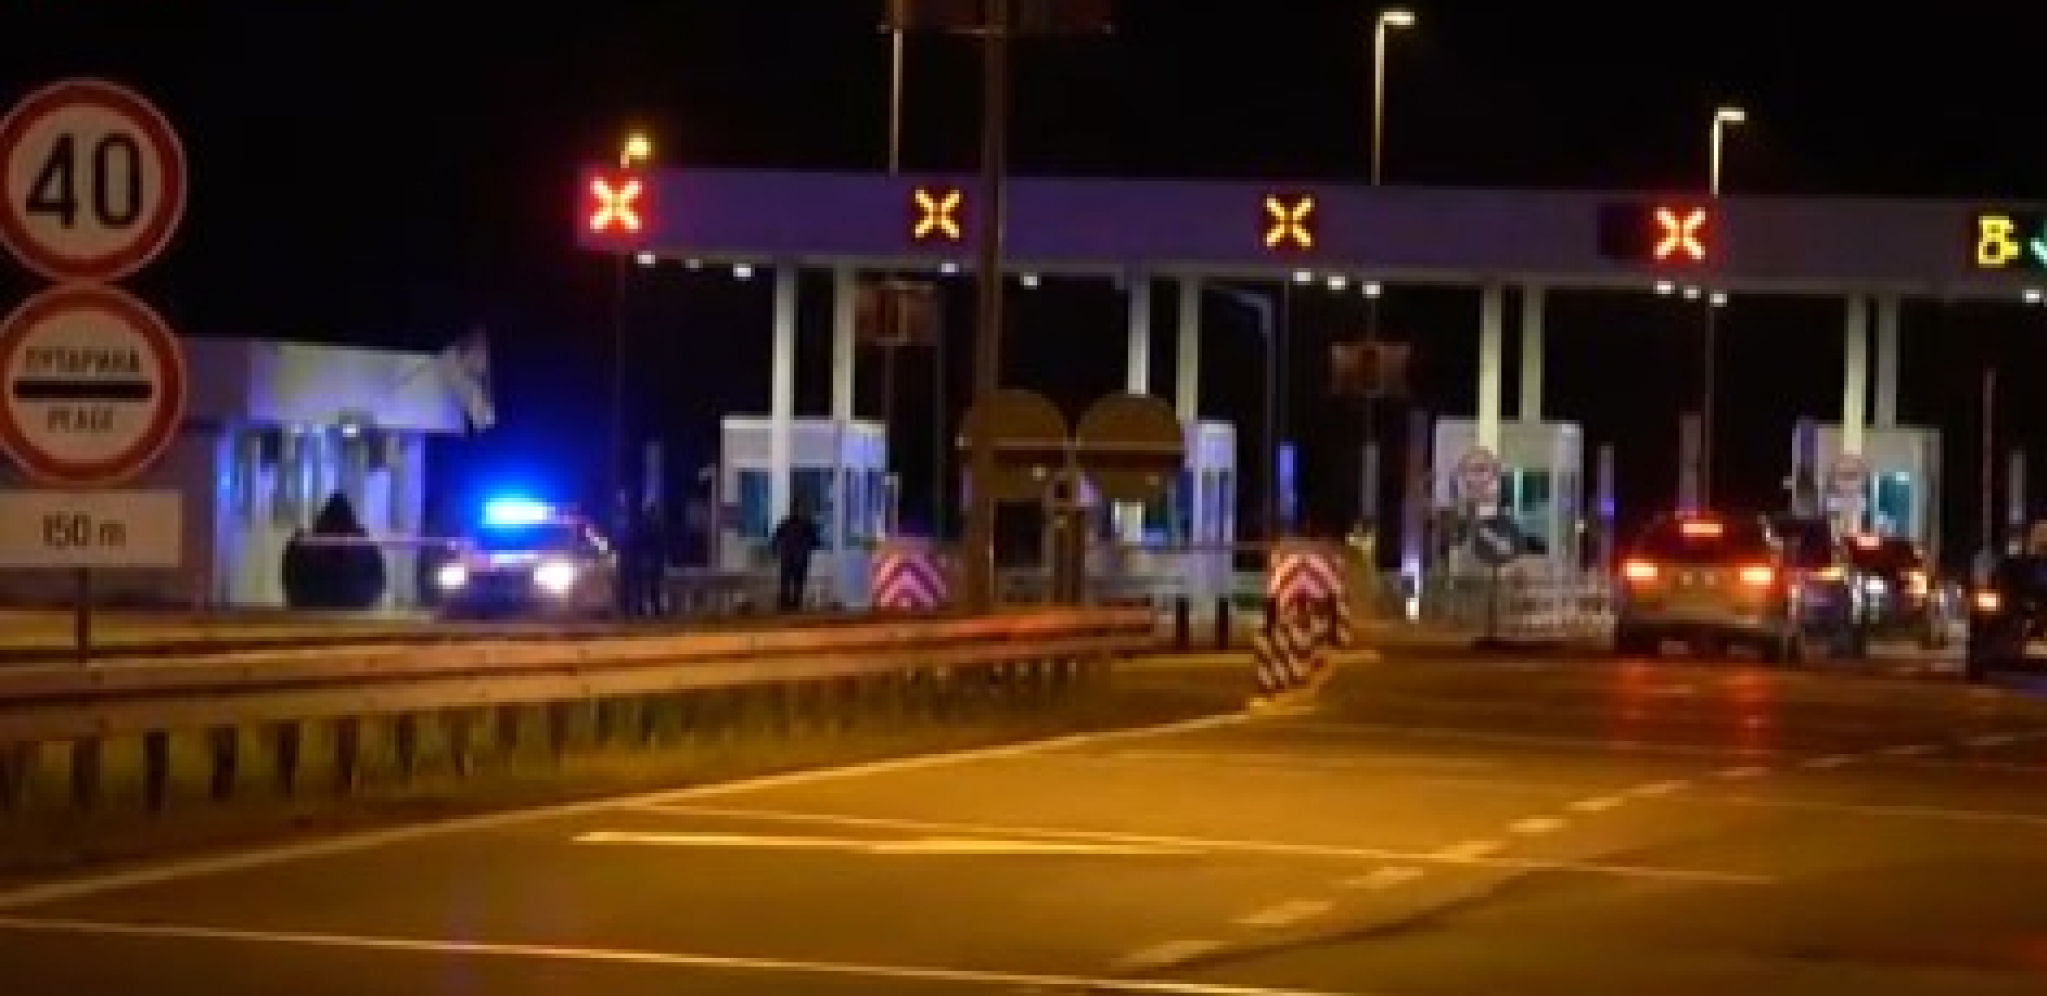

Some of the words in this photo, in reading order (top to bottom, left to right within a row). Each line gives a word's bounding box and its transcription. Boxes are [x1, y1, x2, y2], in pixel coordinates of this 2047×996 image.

[26, 129, 142, 231] 40
[42, 511, 91, 548] 150
[98, 520, 127, 547] m
